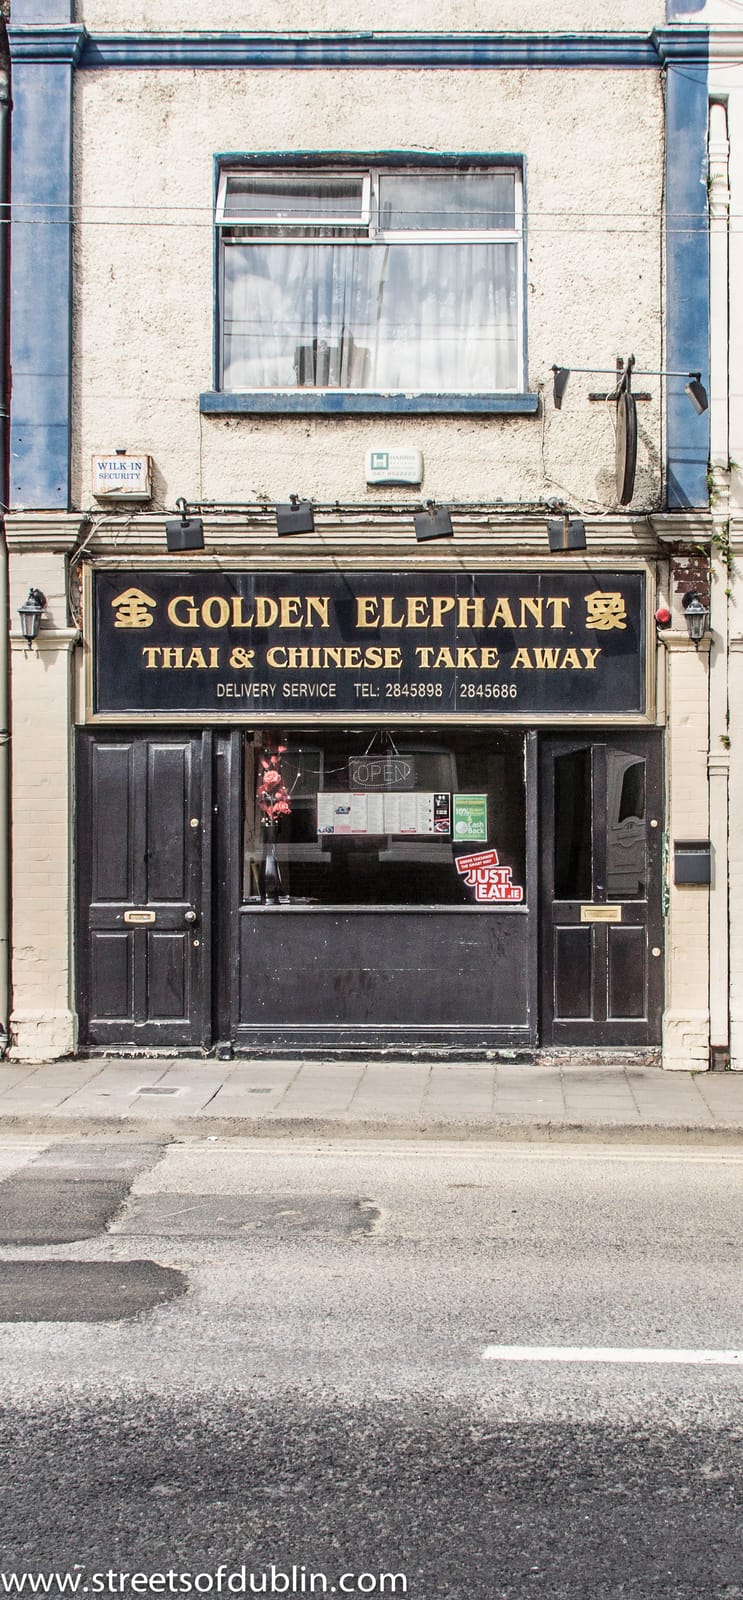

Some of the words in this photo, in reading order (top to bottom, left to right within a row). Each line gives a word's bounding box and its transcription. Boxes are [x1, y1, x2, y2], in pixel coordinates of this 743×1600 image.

[97, 462, 142, 470] WILK-IN
[111, 587, 157, 628] 金
[167, 595, 330, 629] GOLDEN
[355, 596, 570, 628] ELEPHANT
[142, 647, 220, 669] THAI
[229, 646, 255, 669] &
[266, 646, 402, 669] CHINESE
[415, 647, 500, 669] TAKE
[510, 647, 602, 670] AWAY
[216, 683, 276, 697] DELIVERY
[282, 683, 336, 697] SERVICE
[353, 683, 380, 697] TEL:
[385, 683, 443, 697] 2845898
[460, 684, 518, 698] 2845686
[358, 764, 408, 781] OPEN
[468, 870, 508, 883] JUST
[479, 884, 520, 898] EAT.IE
